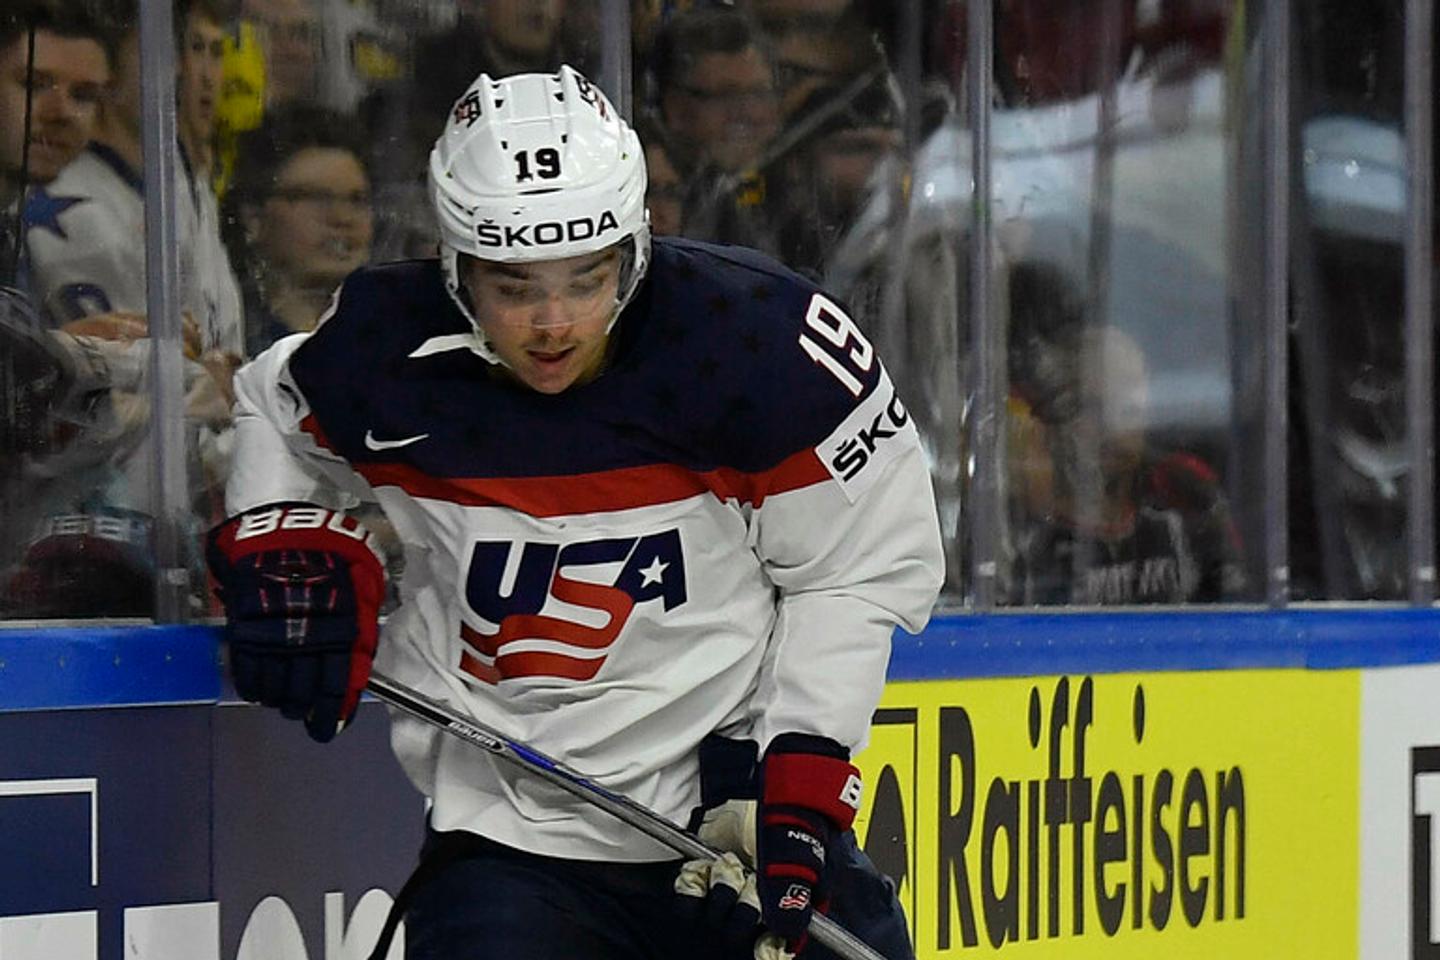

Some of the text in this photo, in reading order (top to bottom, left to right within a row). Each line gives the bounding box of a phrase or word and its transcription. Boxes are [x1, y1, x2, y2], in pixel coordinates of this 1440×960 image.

[513, 148, 561, 183] 19
[476, 210, 619, 248] ŠKODA
[799, 293, 874, 397] 19
[832, 394, 907, 482] ŠKO
[460, 528, 688, 686] USA
[937, 675, 1246, 951] Raiffeisen
